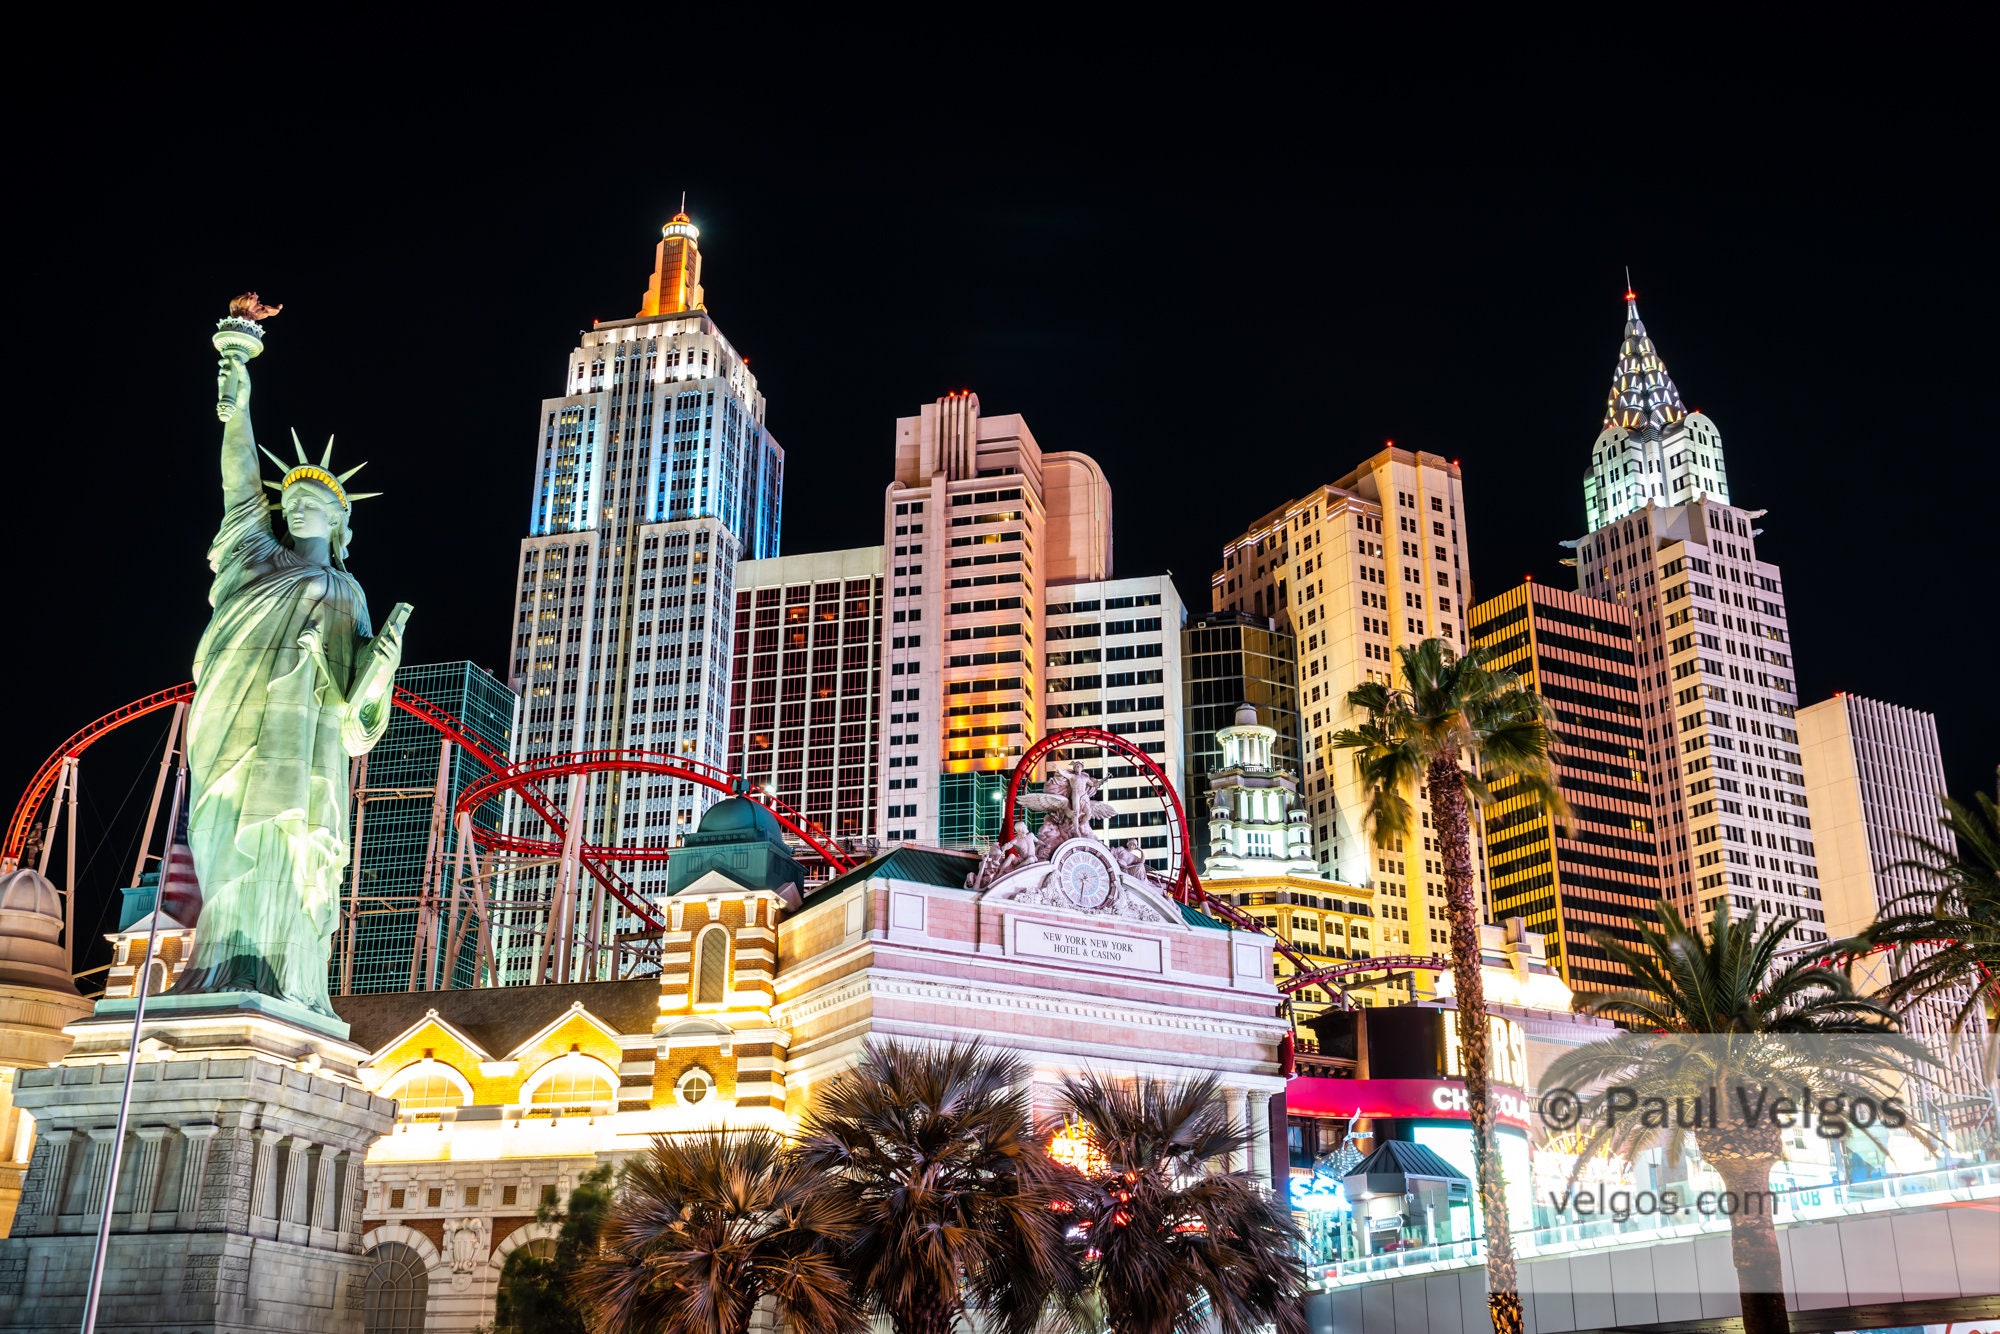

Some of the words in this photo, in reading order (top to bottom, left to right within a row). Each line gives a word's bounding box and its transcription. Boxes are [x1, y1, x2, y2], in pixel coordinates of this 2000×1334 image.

[1043, 931, 1061, 942] NEW
[1065, 935, 1087, 946] YORK
[1090, 938, 1108, 948] NEW
[1111, 941, 1134, 952] YORK
[1054, 944, 1080, 956] HOTEL
[1083, 949, 1088, 957] &
[1091, 949, 1121, 961] CASINO
